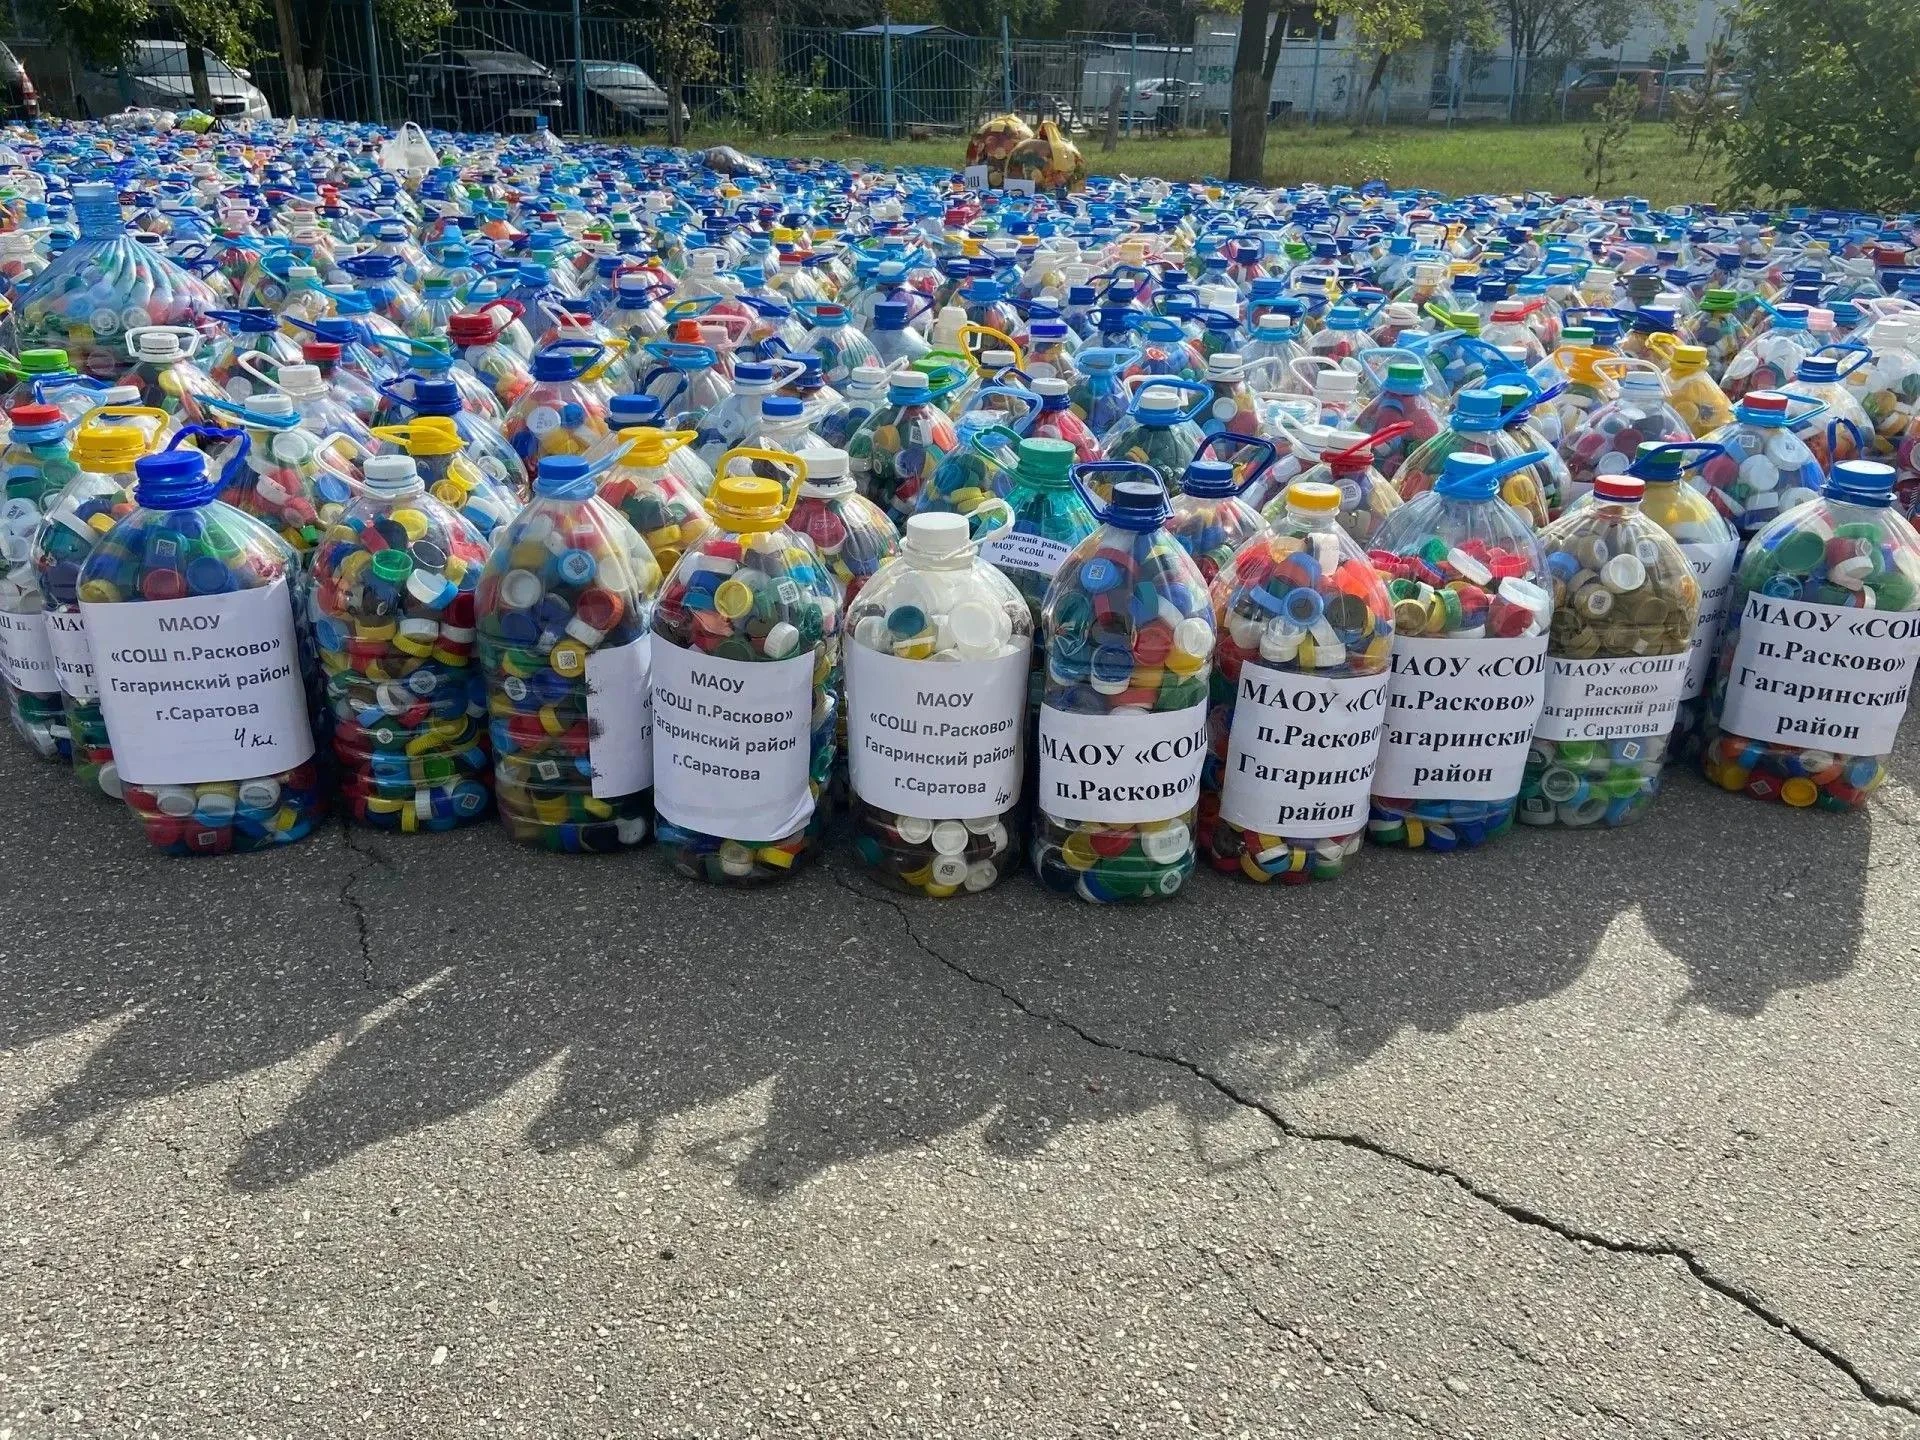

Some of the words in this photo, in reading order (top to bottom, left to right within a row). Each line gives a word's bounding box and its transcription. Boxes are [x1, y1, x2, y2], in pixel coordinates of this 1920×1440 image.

[991, 542, 1014, 551] МАОУ
[1018, 546, 1045, 558] «СОШ
[1003, 534, 1038, 545] инский
[1041, 541, 1067, 553] район
[1000, 554, 1040, 568] Расково»
[158, 615, 220, 632] МАОУ
[1745, 599, 1842, 633] МАОУ
[111, 648, 168, 663] «СОШ
[173, 639, 281, 661] п.Расково»
[1758, 641, 1906, 672] п.Расково»
[111, 673, 231, 696] Гагаринский
[236, 664, 290, 690] район
[1553, 661, 1615, 677] МАОУ
[1620, 659, 1674, 675] «СОШ
[691, 670, 744, 694] МАОУ
[1584, 683, 1658, 697] Расково»
[1738, 667, 1907, 707] Гагаринский
[656, 686, 692, 712] «СОШ
[697, 704, 793, 724] п.Расково»
[916, 691, 974, 708] МАОУ
[1241, 677, 1339, 714] МАОУ
[1345, 684, 1387, 713] «СО
[1390, 690, 1535, 711] п.Расково»
[156, 703, 260, 722] г.Саратова
[1544, 701, 1643, 720] агаринский
[1647, 699, 1676, 716] рай
[653, 708, 740, 752] Гагаринский
[745, 737, 796, 755] район
[870, 711, 917, 734] «СОШ
[922, 718, 1014, 737] п.Расково»
[1566, 728, 1578, 738] г.
[1583, 723, 1659, 739] Саратова
[1775, 715, 1860, 740] район
[1257, 724, 1380, 749] п.Расково
[1382, 722, 1533, 752] агарински
[865, 735, 968, 766] Гагаринский
[973, 745, 1016, 768] район
[1041, 733, 1125, 766] МАОУ
[673, 753, 760, 781] г.Саратова
[1236, 752, 1376, 790] Гагаринск
[1412, 763, 1493, 786] район
[894, 776, 986, 796] г.Саратова
[1056, 773, 1196, 802] п.Расково»
[1277, 801, 1355, 825] район
